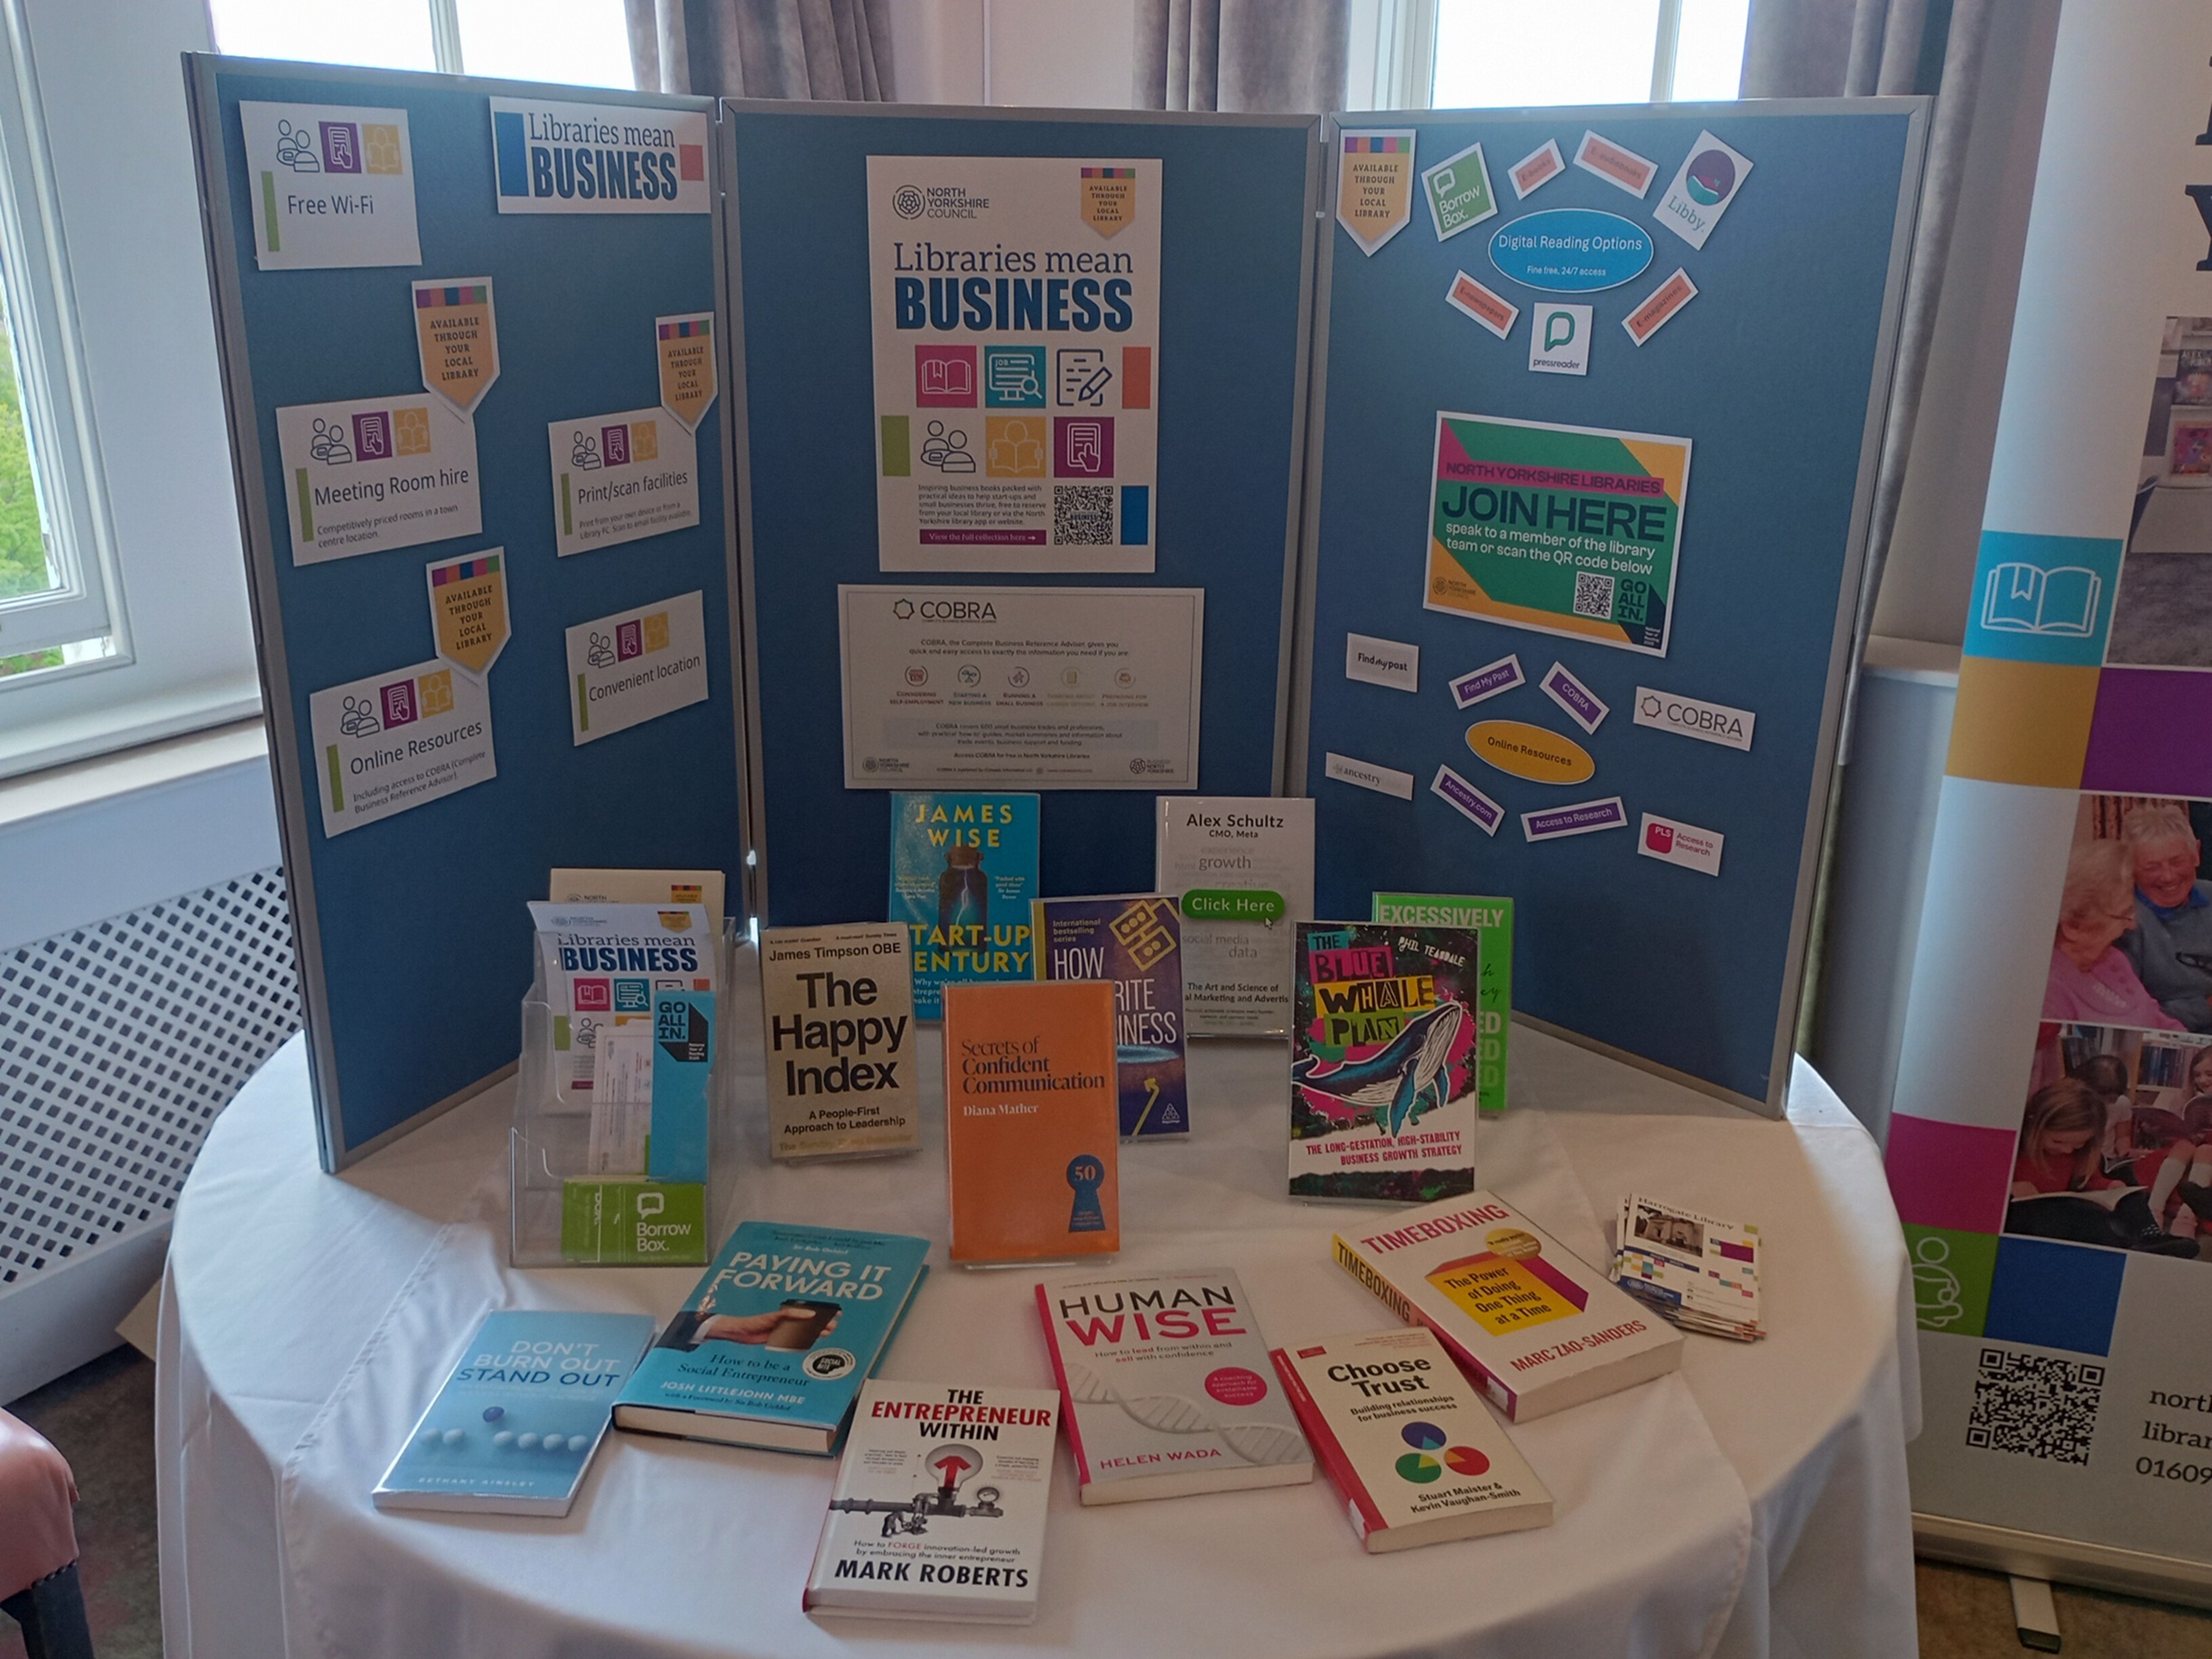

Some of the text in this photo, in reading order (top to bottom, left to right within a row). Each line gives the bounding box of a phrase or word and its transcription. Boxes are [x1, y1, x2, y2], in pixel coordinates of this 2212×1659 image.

[530, 113, 674, 147] Libraries mean
[532, 147, 677, 200] BUSINESS
[1353, 163, 1399, 173] AVAILABLE
[1354, 175, 1395, 184] THROUGH
[927, 188, 966, 197] NORTH
[1362, 187, 1386, 196] YOUR
[1439, 185, 1481, 214] Borrow
[288, 195, 373, 215] Free Wi-Fi
[927, 199, 990, 209] YORKSHIRE
[1360, 198, 1387, 208] LOCAL
[927, 210, 977, 219] COUNCIL
[1354, 210, 1390, 219] LIBRARY
[1444, 208, 1469, 228] Box.
[1668, 196, 1705, 233] Libby.
[1499, 235, 1642, 252] Digital Reading Options
[894, 243, 1133, 273] Libraries mean
[1528, 266, 1542, 275] Fine
[1544, 266, 1559, 275] free,
[1562, 266, 1578, 275] 24/7
[896, 276, 1132, 331] BUSINESS
[430, 317, 479, 329] AVAILABLE
[434, 331, 478, 342] THROUGH
[445, 344, 469, 354] YOUR
[444, 357, 472, 367] LOCAL
[1533, 358, 1580, 370] pressreader
[442, 368, 479, 381] LIBRARY
[314, 468, 469, 507] Meeting Room hire
[579, 470, 688, 504] Print/scan facilities
[1446, 462, 1661, 494] NORTH YORKSHIRE LIBRARIES
[918, 485, 948, 493] Inspiring
[1002, 485, 1027, 493] packed
[318, 519, 372, 535] Competitively
[374, 514, 398, 527] priced
[400, 510, 423, 520] rooms
[440, 505, 458, 514] town
[1442, 486, 1668, 542] JOIN HERE
[1445, 523, 1655, 560] speak to a member of the library
[1621, 579, 1647, 594] GO
[1618, 592, 1645, 608] ALL
[920, 602, 997, 620] COBRA
[1618, 607, 1643, 621] IN.
[589, 654, 701, 702] Convenient location
[1464, 669, 1510, 695] Find My Past
[1667, 704, 1743, 737] COBRA
[350, 721, 483, 775] Online Resources
[1487, 737, 1573, 767] Online Resources
[915, 804, 1013, 825] JAMES
[1186, 814, 1284, 828] Alex Schultz
[1536, 807, 1613, 828] Access to Research
[928, 828, 1000, 847] WISE
[1192, 898, 1275, 911] Click Here
[1379, 905, 1504, 927] EXCESSIVELY
[769, 943, 901, 961] James Timpson OBE
[1313, 935, 1340, 948] THE
[1055, 946, 1104, 980] HOW
[1316, 951, 1391, 981] BLUE
[796, 971, 877, 1009] The
[1319, 977, 1435, 1014] WHALE
[773, 1014, 907, 1057] Happy
[1332, 1016, 1399, 1046] PLAN
[962, 1036, 1040, 1057] Secrets of
[786, 1057, 899, 1096] Index
[962, 1057, 1049, 1076] Confident
[962, 1073, 1105, 1095] Communication
[809, 1106, 880, 1120] A People-First
[963, 1103, 1039, 1116] Diana Mather
[785, 1116, 906, 1135] Approach to Leadership
[1306, 1132, 1460, 1155] THE LONG-GESTATION, HIGH-STABILITY
[1341, 1145, 1463, 1165] BUSINESS GROWTH STRATEGY
[1362, 1204, 1509, 1254] TIMEBOXING
[730, 1252, 891, 1282] PAYING IT
[714, 1270, 883, 1300] FORWARD
[1337, 1243, 1410, 1322] TIMEBOXING
[1445, 1266, 1510, 1291] The Power
[1467, 1279, 1517, 1300] of Doing
[1059, 1286, 1234, 1319] HUMAN
[1474, 1291, 1539, 1314] One Thing
[1495, 1303, 1552, 1324] at a Time
[1065, 1308, 1247, 1347] WISE
[511, 1341, 599, 1356] DON'T
[1510, 1320, 1647, 1372] MARC ZAO-SANDERS
[474, 1355, 620, 1372] BURN OUT
[1327, 1356, 1431, 1383] Choose
[457, 1368, 620, 1386] STAND OUT
[678, 1364, 810, 1387] Social Entrepreneur
[660, 1382, 805, 1404] JOSH LITTLEJOHN MBE
[948, 1389, 983, 1404] THE
[1352, 1375, 1430, 1398] Trust
[871, 1402, 1051, 1426] ENTREPRENEUR
[919, 1422, 999, 1440] WITHIN
[1100, 1449, 1222, 1468] HELEN WADA
[1410, 1488, 1520, 1515] Kevin Vaughan-Smith
[1418, 1482, 1502, 1503] Stuart Maister &
[834, 1560, 1028, 1588] MARK ROBERTS
